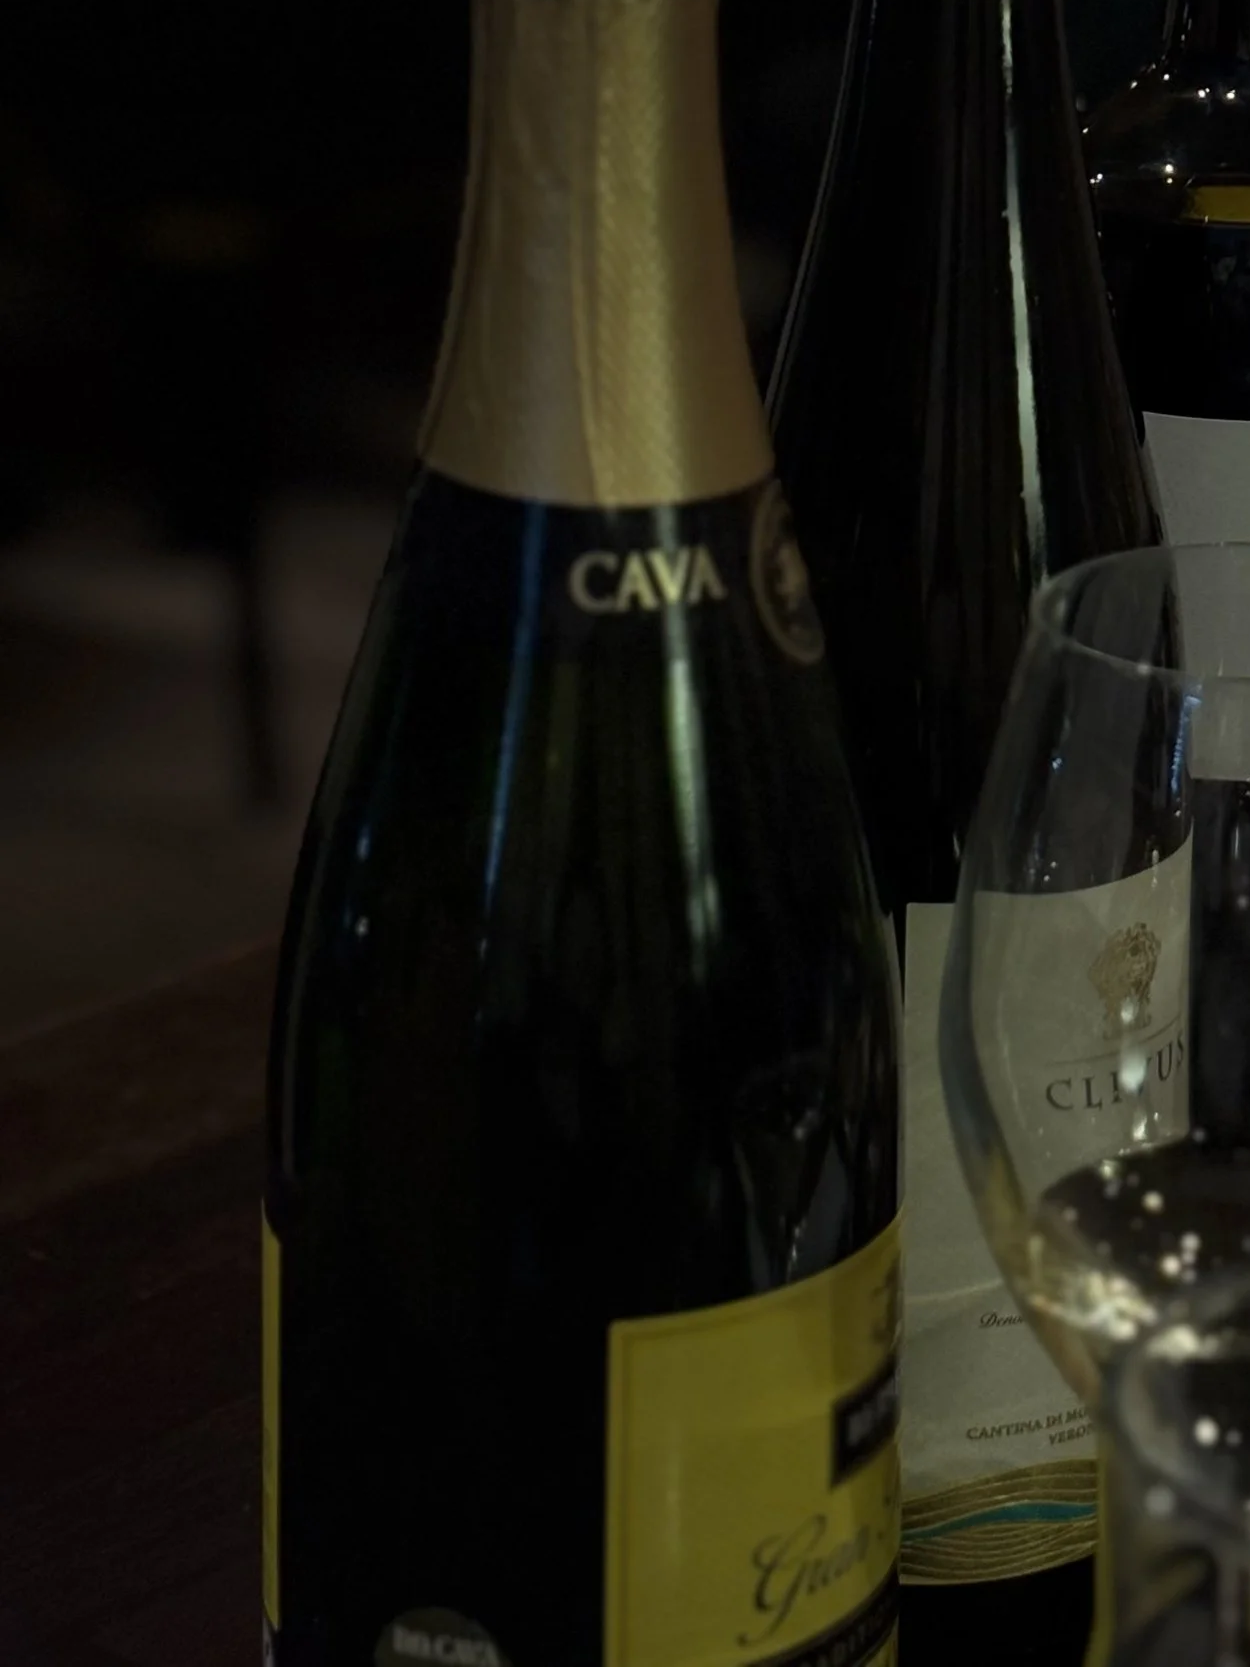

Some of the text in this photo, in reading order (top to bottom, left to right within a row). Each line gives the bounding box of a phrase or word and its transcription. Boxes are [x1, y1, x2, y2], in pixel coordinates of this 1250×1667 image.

[567, 543, 728, 616] CAVA
[1045, 1033, 1184, 1110] CLIUS
[966, 1419, 1042, 1440] CANTINA
